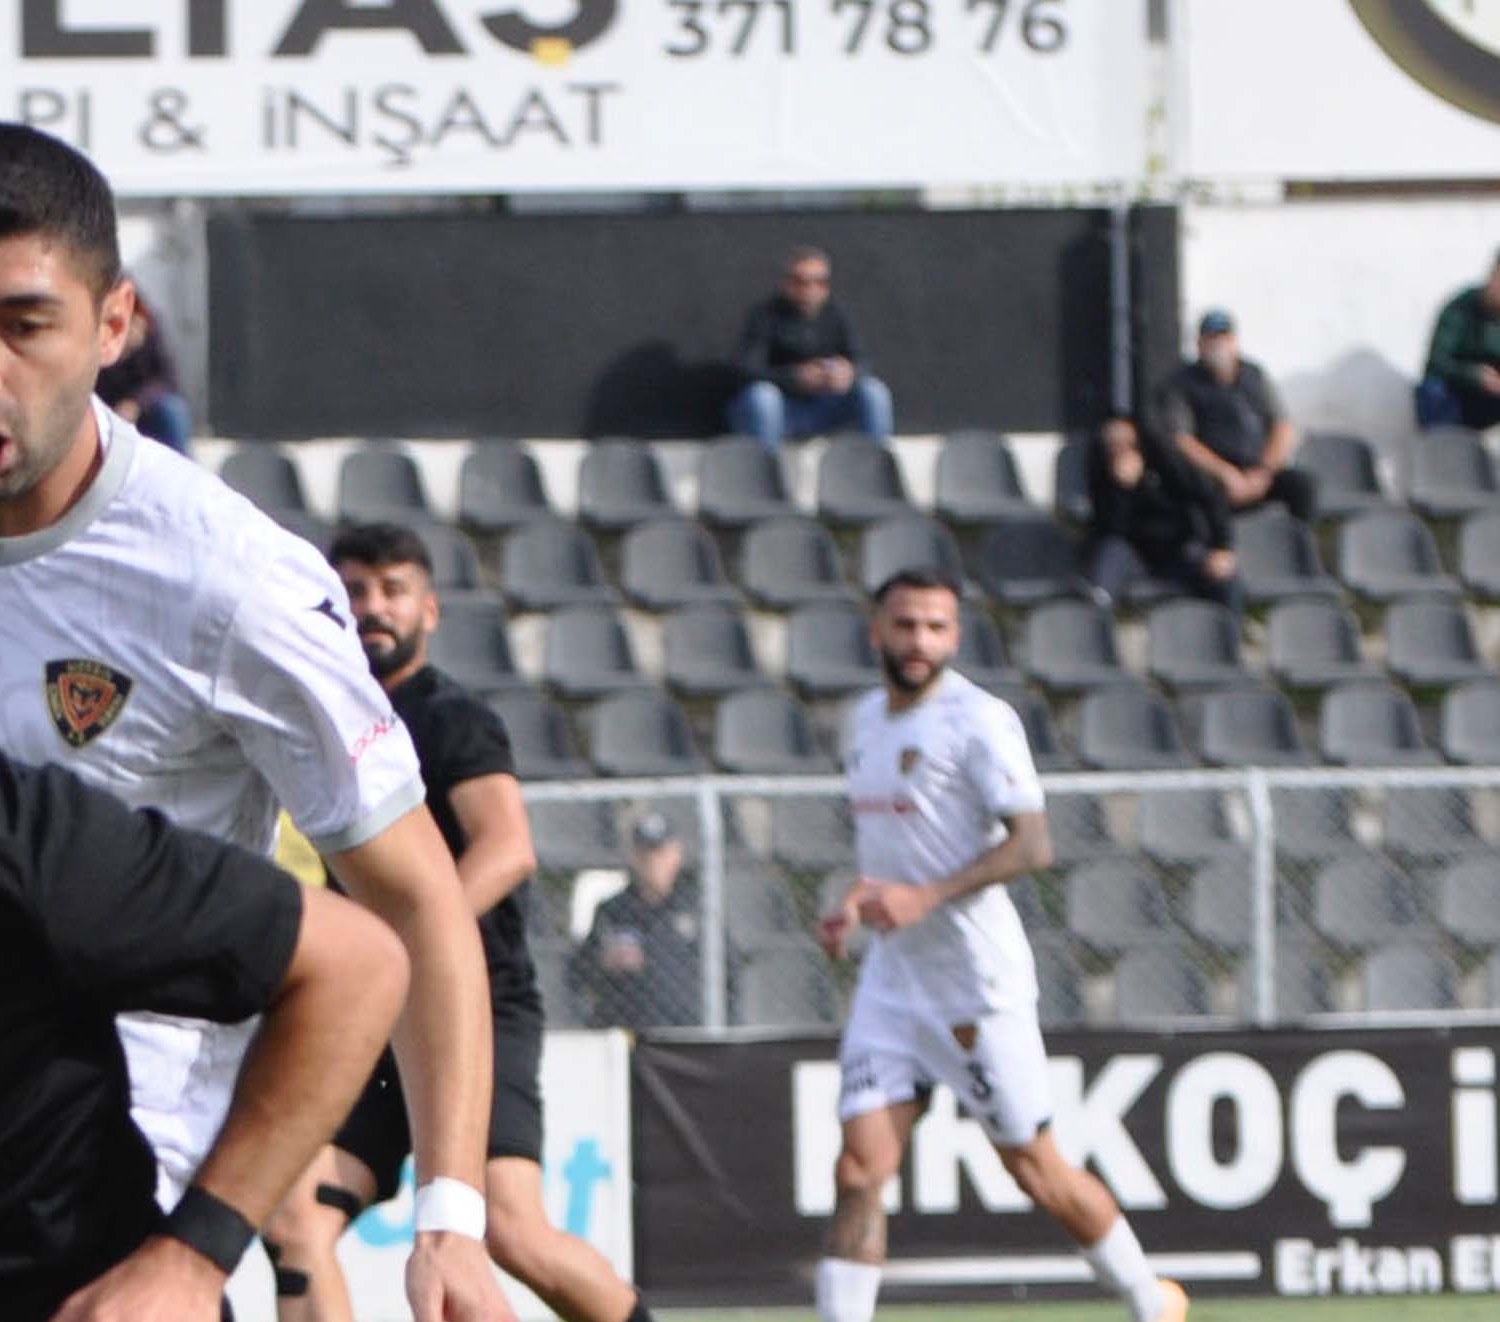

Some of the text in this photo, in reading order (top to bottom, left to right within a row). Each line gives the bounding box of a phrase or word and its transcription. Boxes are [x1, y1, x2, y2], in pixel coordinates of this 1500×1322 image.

[664, 0, 797, 56] 371
[829, 0, 932, 55] 78
[964, 0, 1069, 53] 76
[138, 86, 207, 154] &
[1275, 1236, 1444, 1296] Erkan
